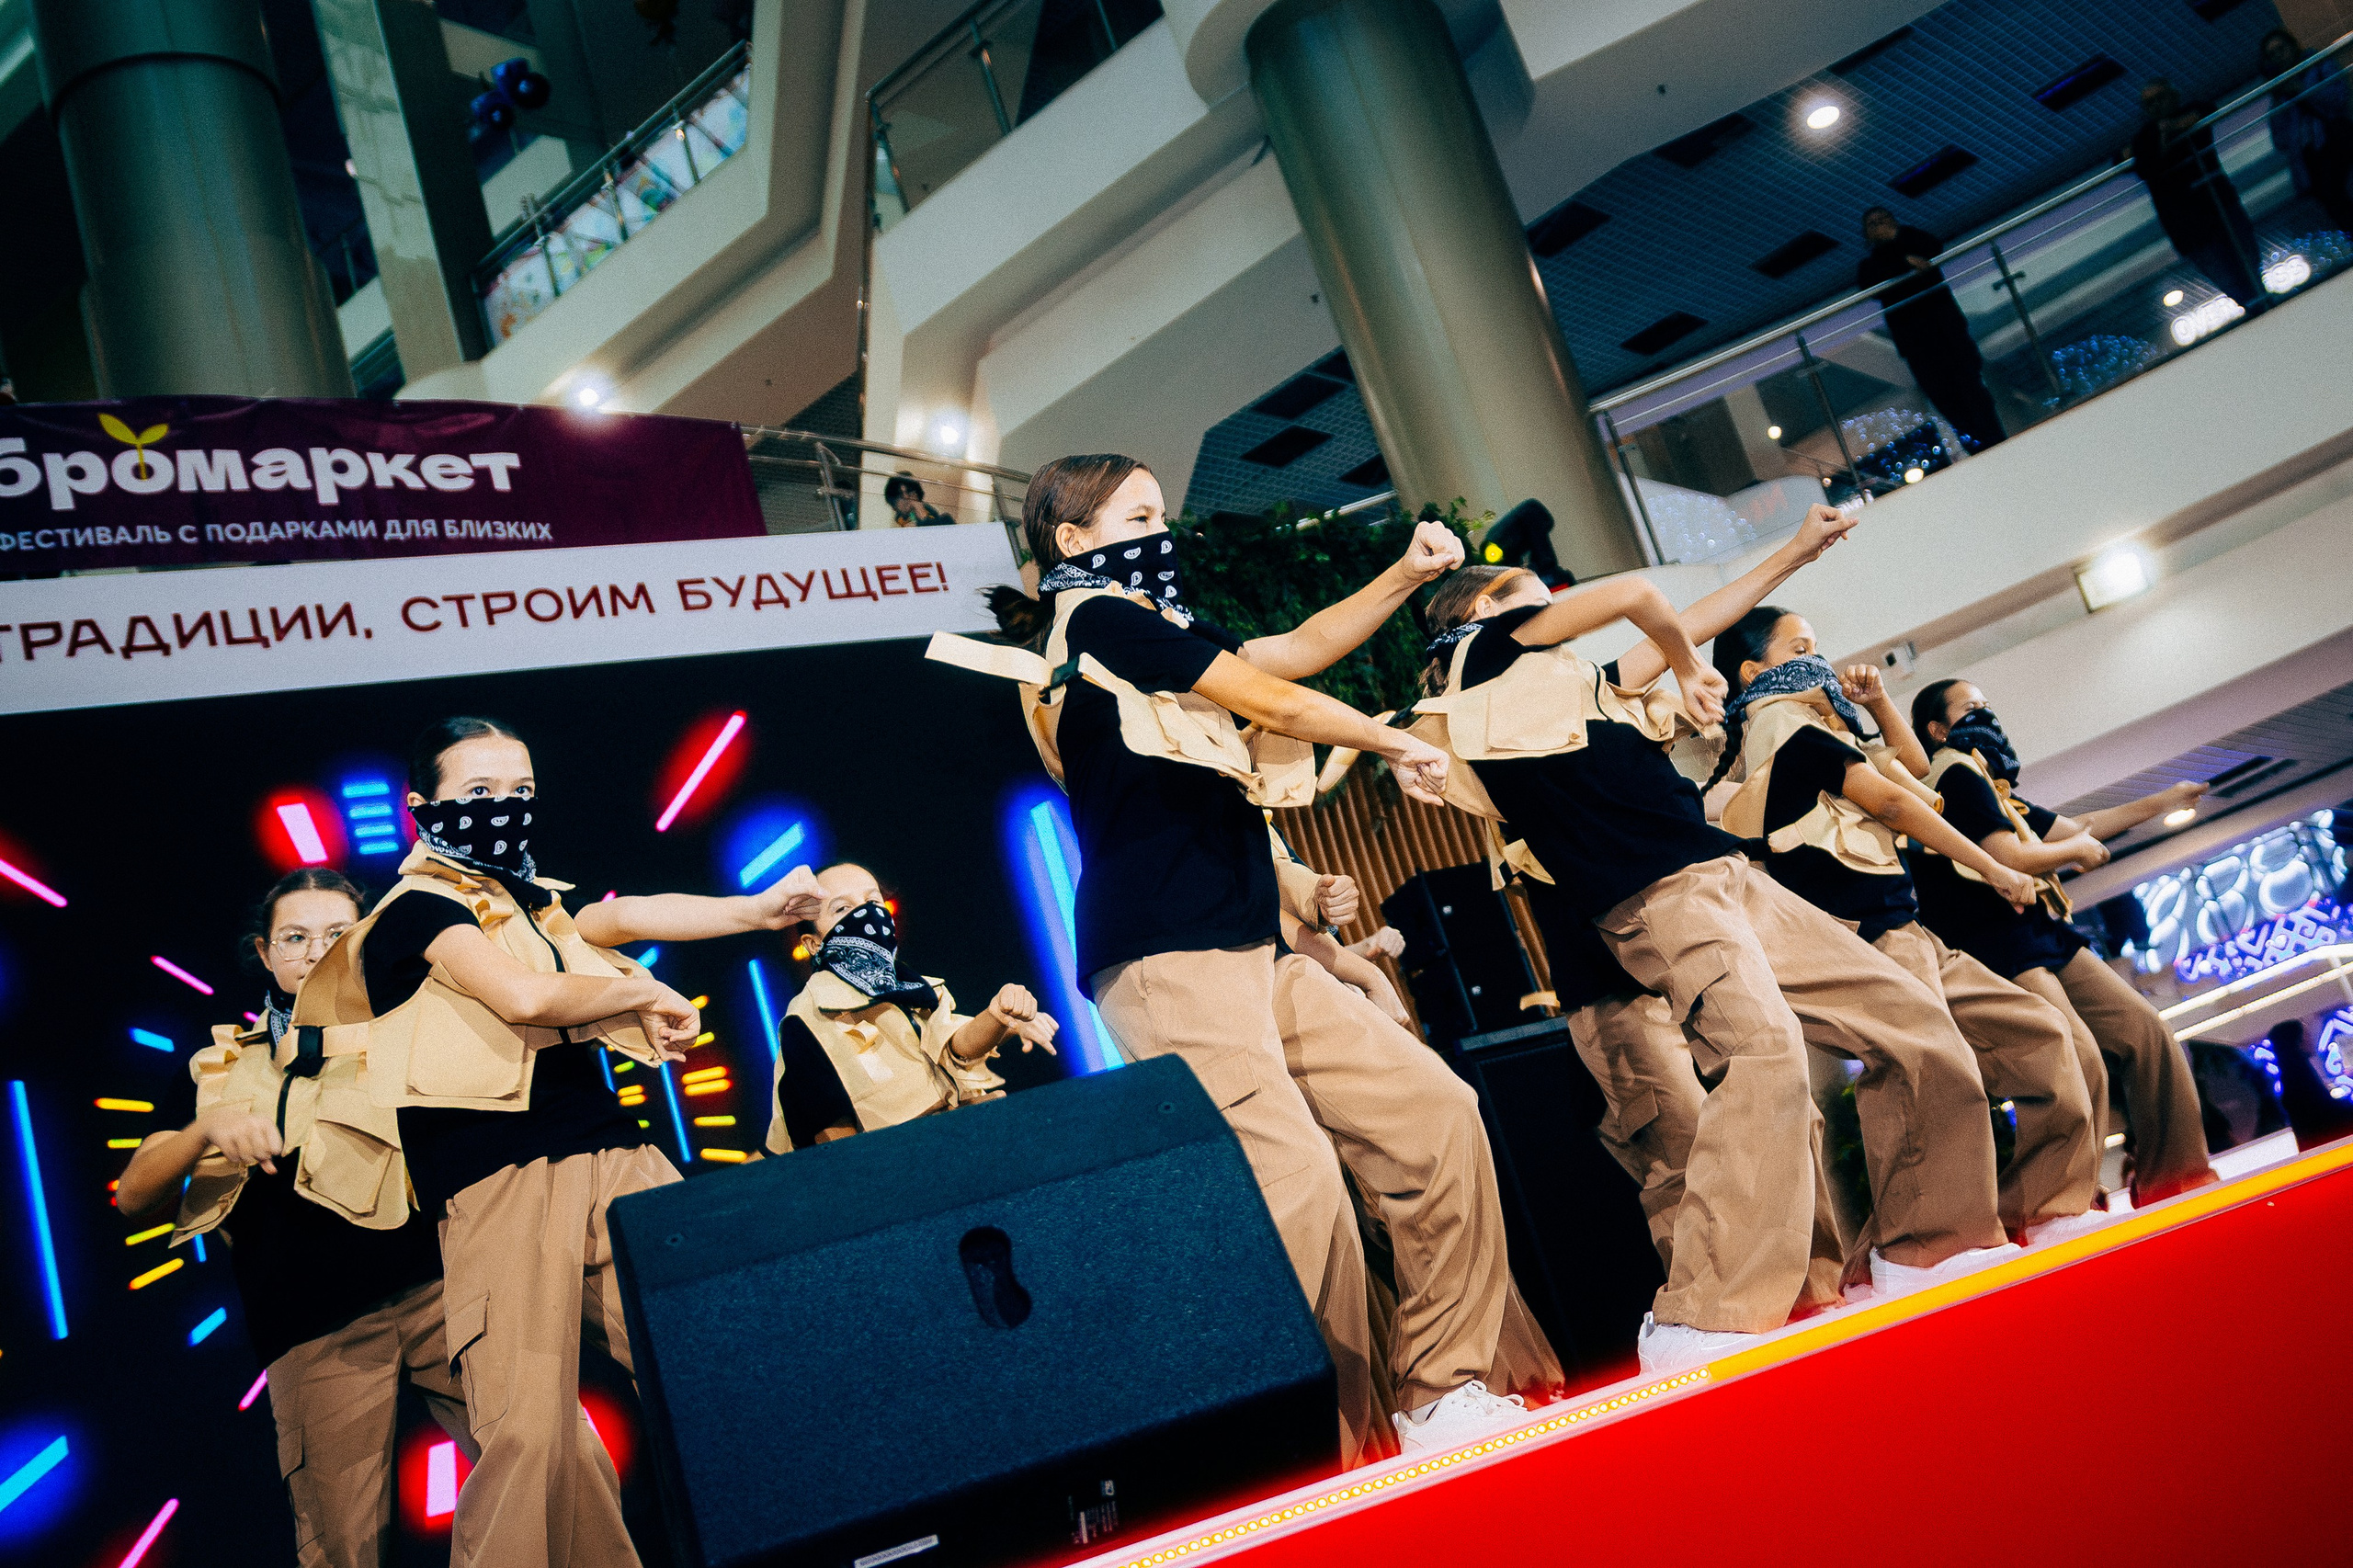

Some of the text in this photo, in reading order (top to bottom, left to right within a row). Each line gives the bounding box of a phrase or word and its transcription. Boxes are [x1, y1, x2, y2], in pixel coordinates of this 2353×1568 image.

[177, 524, 199, 544] С
[205, 518, 378, 545] ПОДАРКАМИ
[383, 518, 438, 542] ДЛЯ
[443, 518, 553, 541] БЛИЗКИХ
[401, 582, 656, 634] СТРОИМ
[676, 562, 949, 611] БУДУЩЕЕ!
